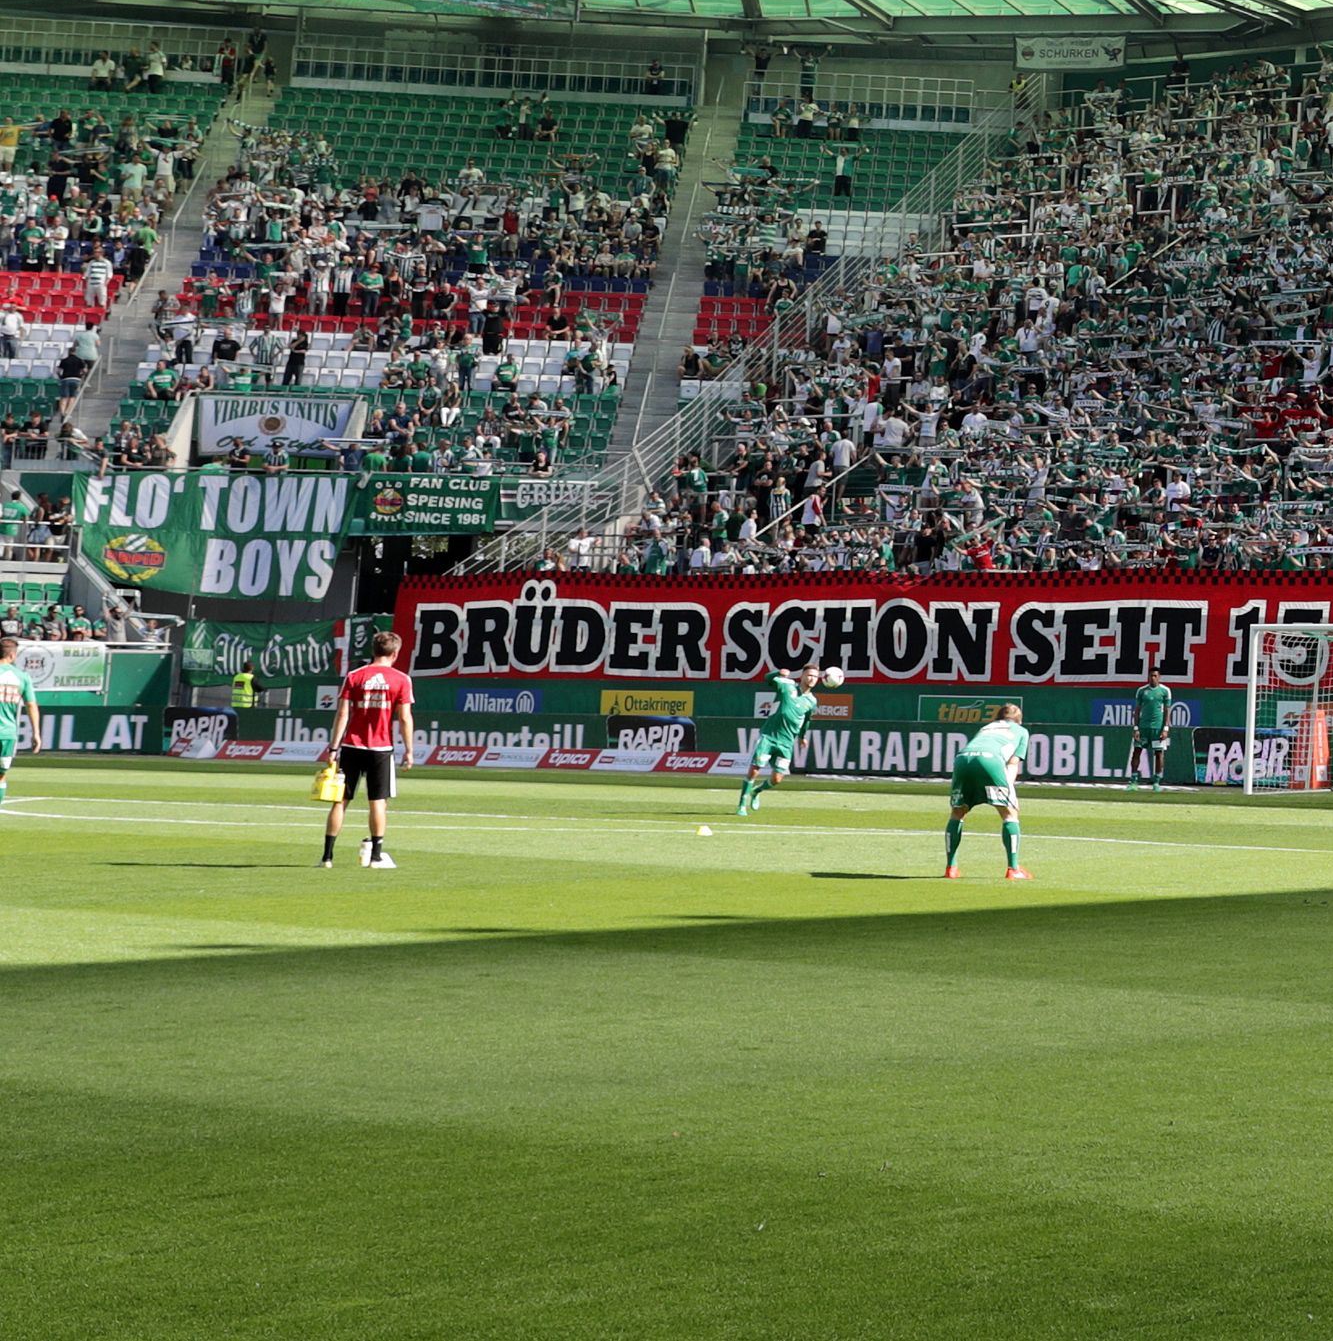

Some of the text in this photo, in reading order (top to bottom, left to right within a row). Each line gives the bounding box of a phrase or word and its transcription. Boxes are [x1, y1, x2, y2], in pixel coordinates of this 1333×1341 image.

[1038, 49, 1099, 59] SCHURKEN
[213, 400, 339, 431] VIRIBUS UNITIS
[409, 477, 491, 491] FAN CLUB
[199, 475, 349, 533] TOWN
[407, 493, 484, 509] SPEISING
[404, 510, 487, 525] SINCE 1981
[200, 538, 336, 600] BOYS
[410, 579, 711, 678] BRÜDER
[721, 597, 1000, 682] SCHON
[1009, 598, 1208, 684] SEIT
[261, 634, 334, 677] Garde
[464, 693, 513, 714] Allianz
[624, 695, 688, 715] Ottakringer
[811, 705, 848, 717] NERGIE
[225, 740, 263, 757] tipico
[436, 746, 476, 762] tipico
[549, 749, 591, 766] tipico
[665, 753, 709, 770] tipico
